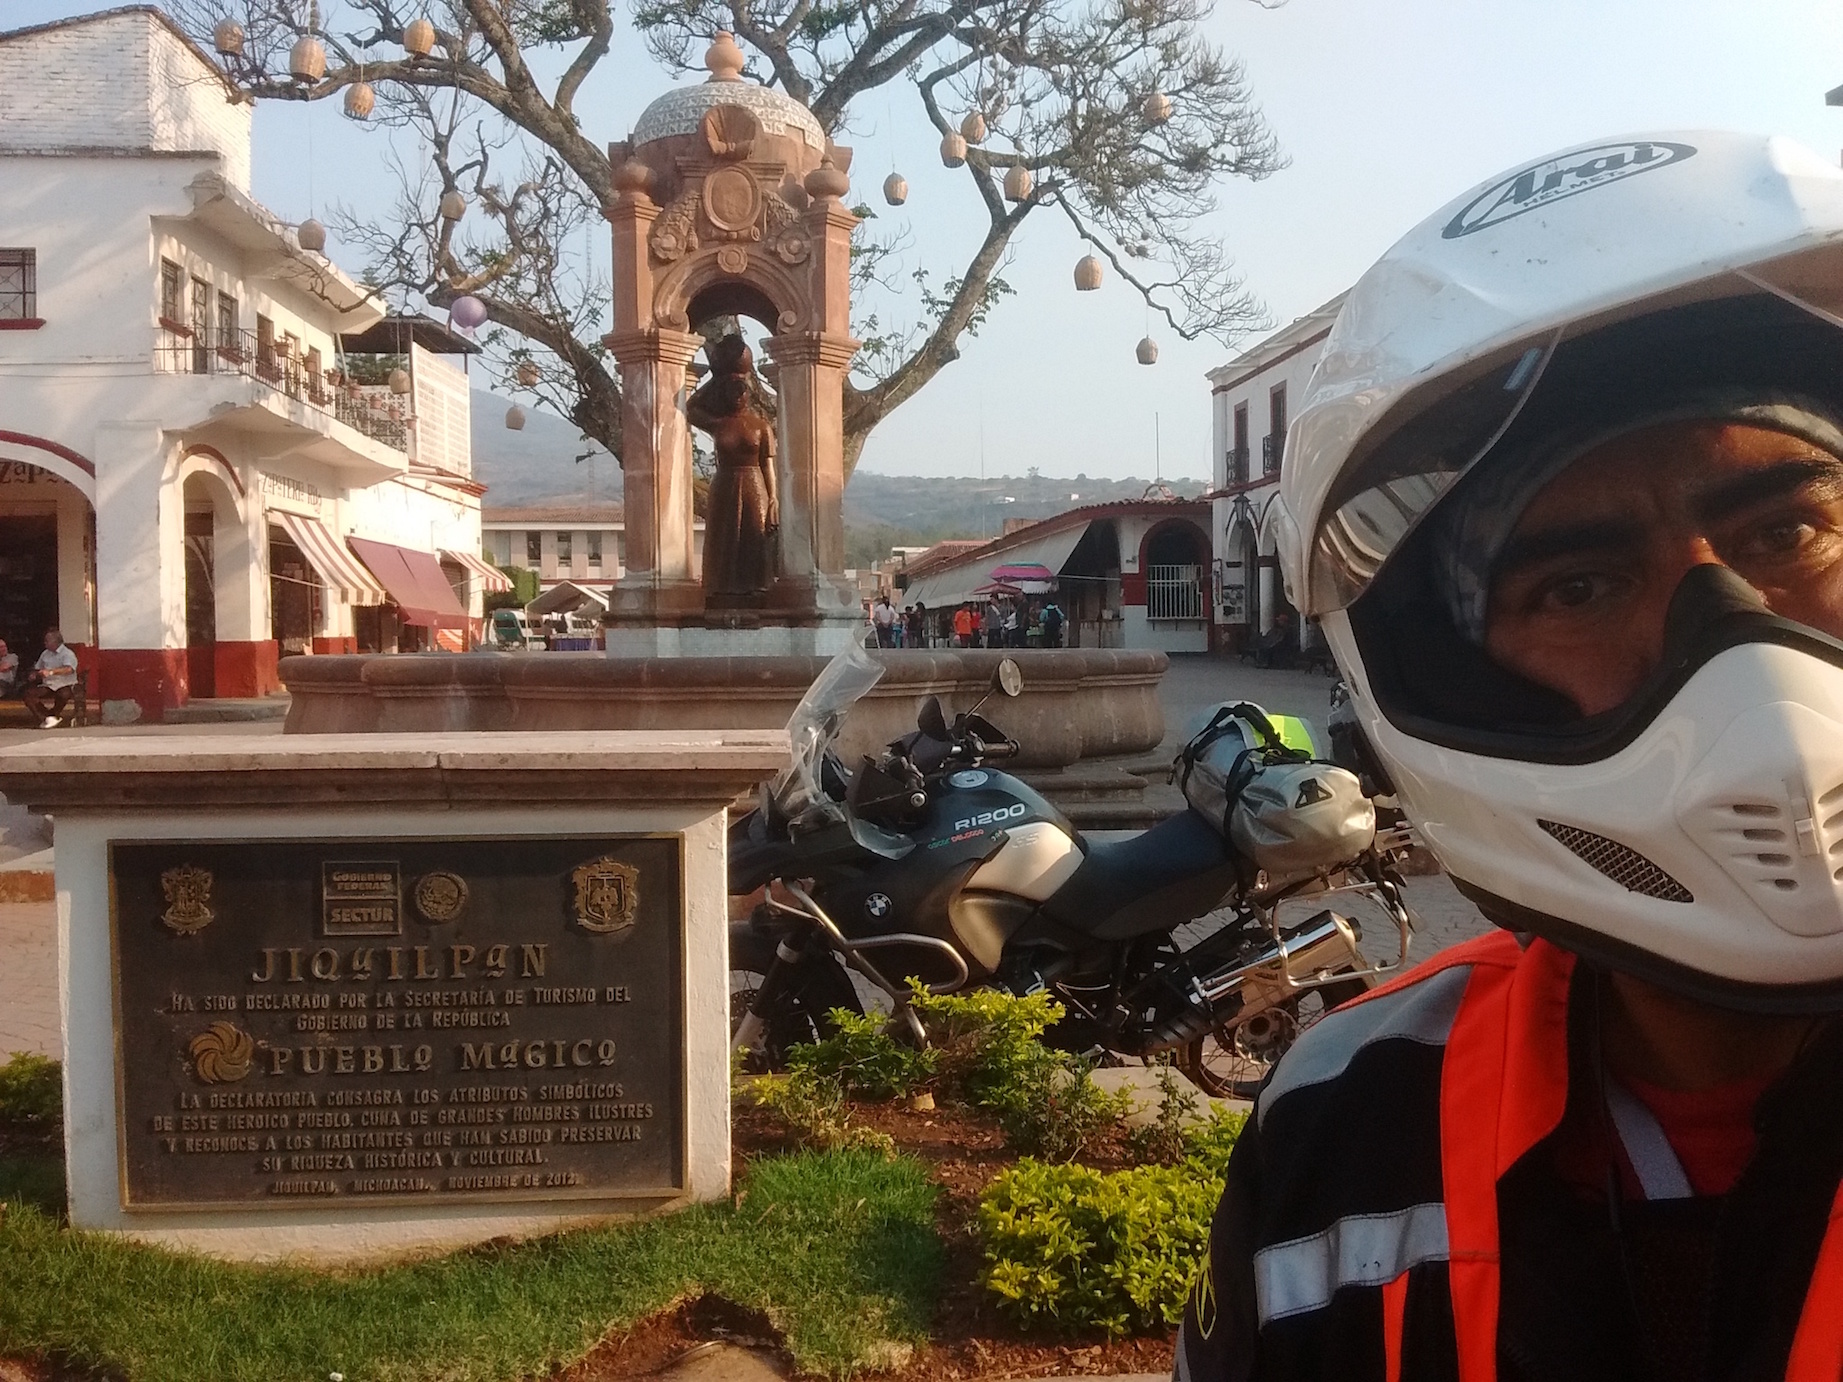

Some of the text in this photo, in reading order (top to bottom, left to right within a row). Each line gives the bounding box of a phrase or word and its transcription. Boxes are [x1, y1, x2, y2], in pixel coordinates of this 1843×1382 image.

[1461, 142, 1666, 234] Arai
[954, 803, 1026, 831] R1200
[331, 907, 394, 922] SECTUR
[172, 986, 631, 1011] HA SIDO DECLARADO POR LA SECRETARÍA DE TURISMO DEL
[297, 1008, 510, 1031] GOBIERNO DE LA REPÚBLICA
[180, 1080, 624, 1109] LA DECLARATORIA CONSAGRA LOS ATRIBUTOS SIMBÓLICOS
[154, 1115, 173, 1131] DE
[182, 1114, 218, 1131] ESTE
[228, 1113, 288, 1130] HEROICO
[361, 1110, 400, 1127] CUNA
[410, 1110, 428, 1125] DE
[438, 1108, 505, 1124] GRANDES
[513, 1105, 580, 1122] HOMBRES
[589, 1103, 654, 1119] ILUSTRES
[166, 1125, 642, 1152] Y RECONOCE A LOS HABITANTES QUE HAN SABIDO PRESERVAR
[262, 1148, 549, 1172] SU RIQUEZA HISTÓRICA Y CULTURAL.
[448, 1174, 518, 1190] NOVIEMBRE
[524, 1174, 540, 1187] DE
